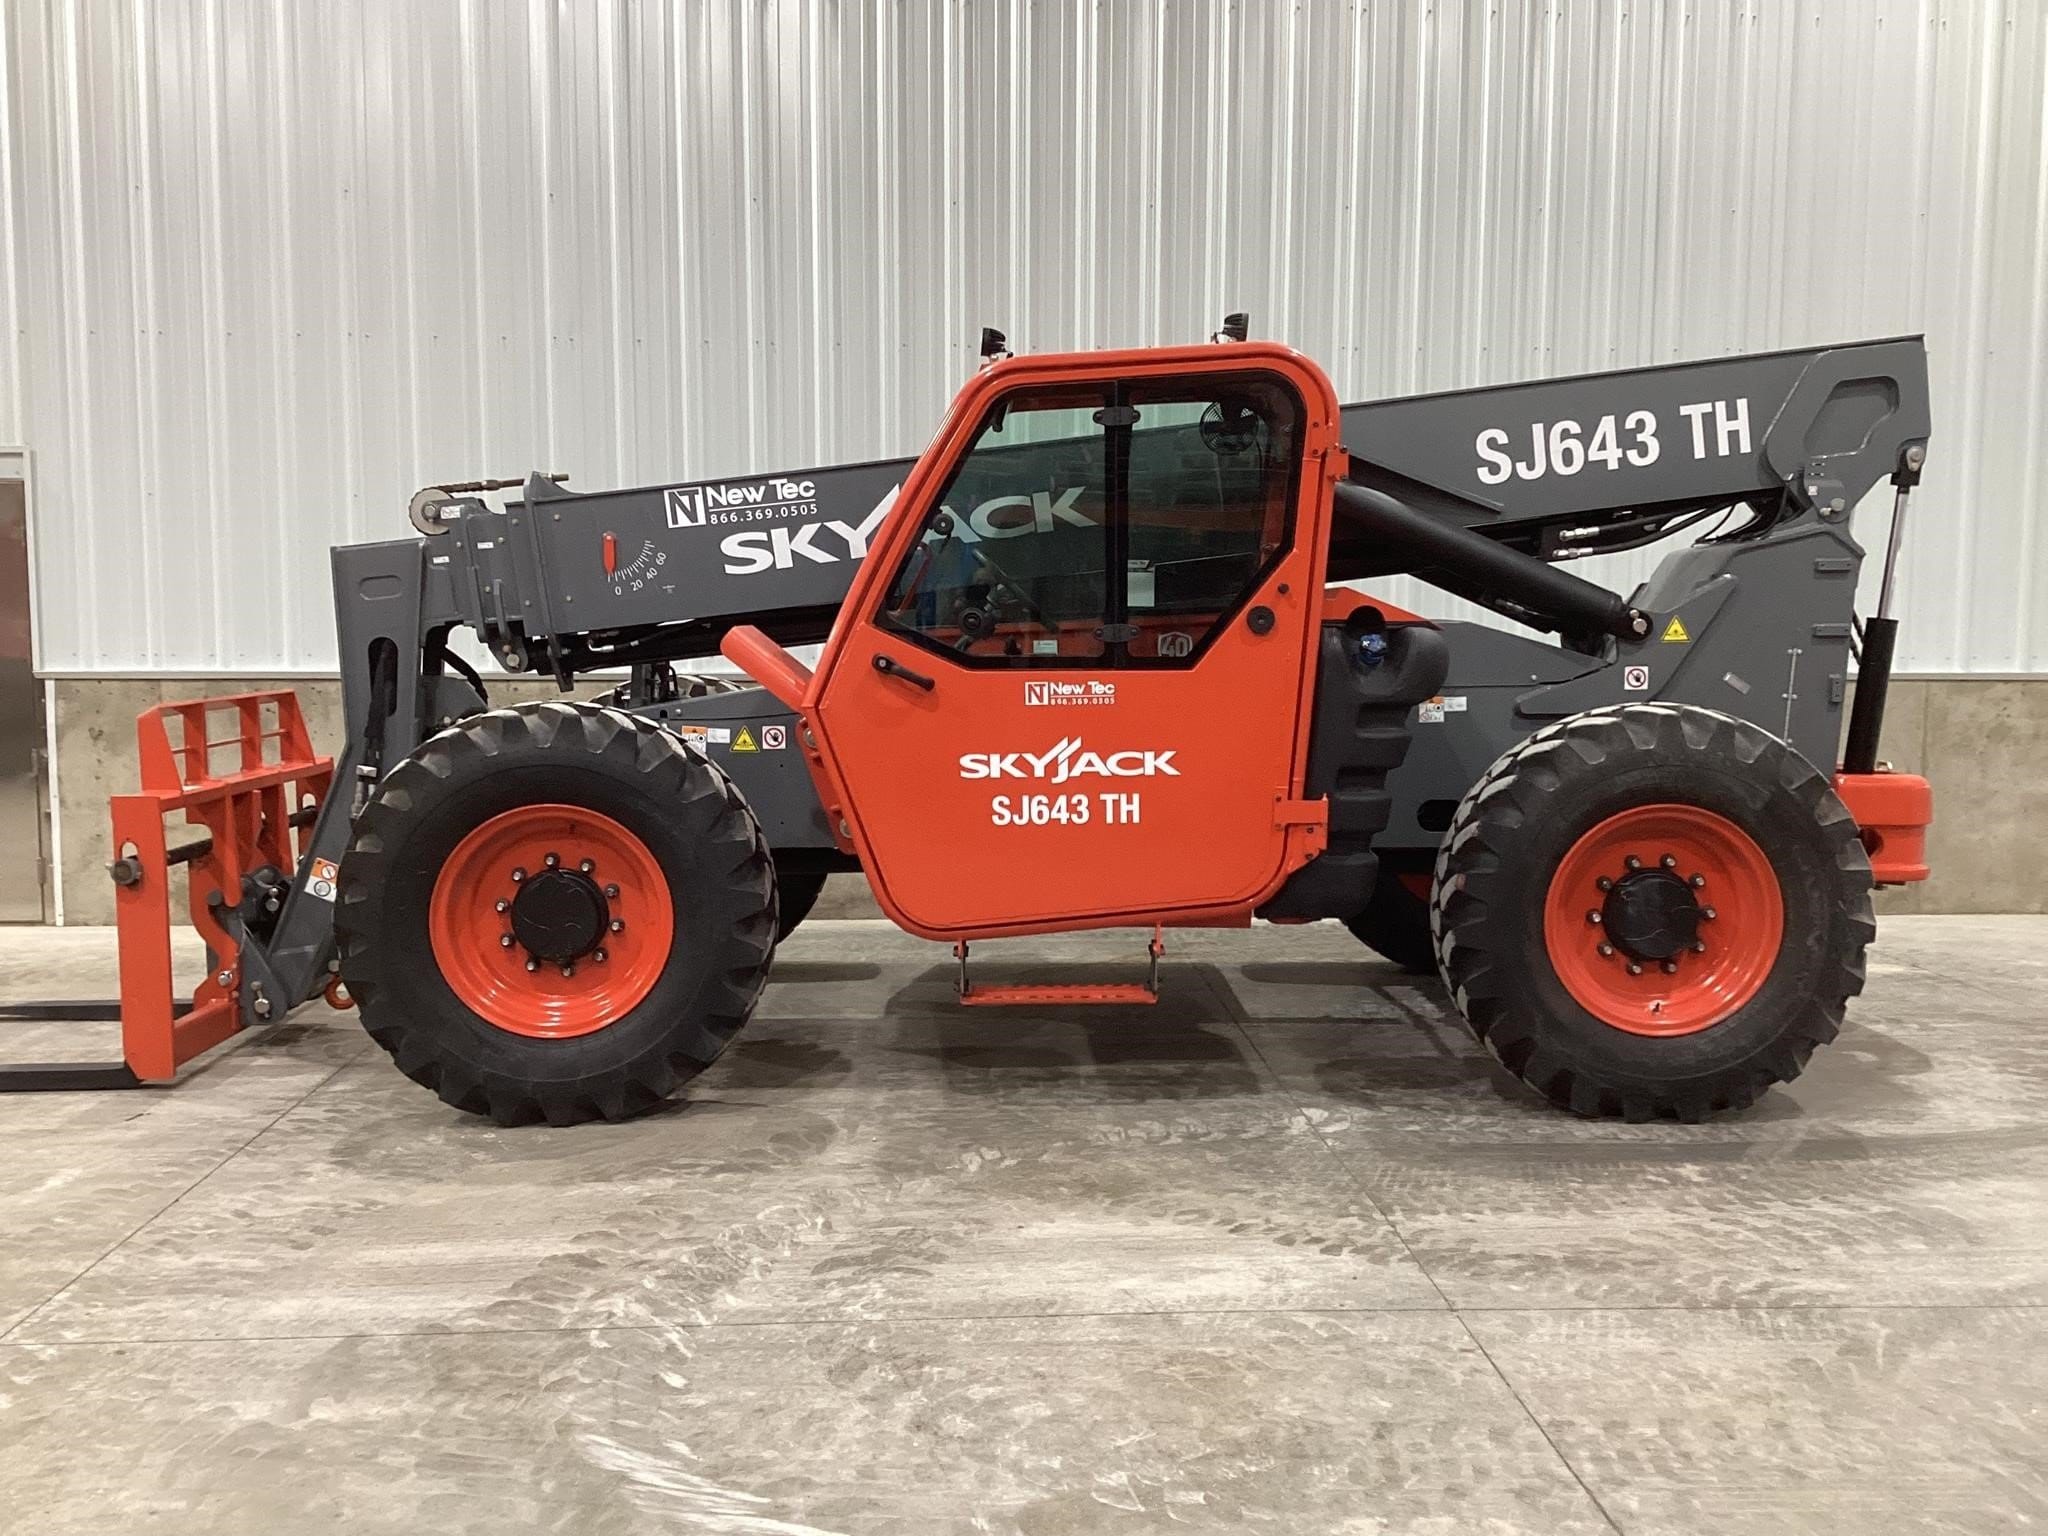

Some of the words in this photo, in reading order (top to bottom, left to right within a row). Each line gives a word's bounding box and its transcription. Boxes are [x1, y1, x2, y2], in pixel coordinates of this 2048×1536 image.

[1475, 409, 1661, 485] SJ643
[1679, 397, 1752, 460] TH
[706, 484, 766, 508] New
[768, 478, 817, 501] Tec
[709, 503, 819, 525] 866.369.0505
[614, 586, 622, 596] 0
[630, 579, 644, 592] 20
[645, 567, 658, 580] 40
[655, 551, 667, 566] 60
[1049, 681, 1086, 696] New
[1087, 680, 1116, 695] Tec
[959, 736, 1182, 784] SKYJACK
[991, 794, 1090, 826] SJ643
[1099, 793, 1141, 824] TH
